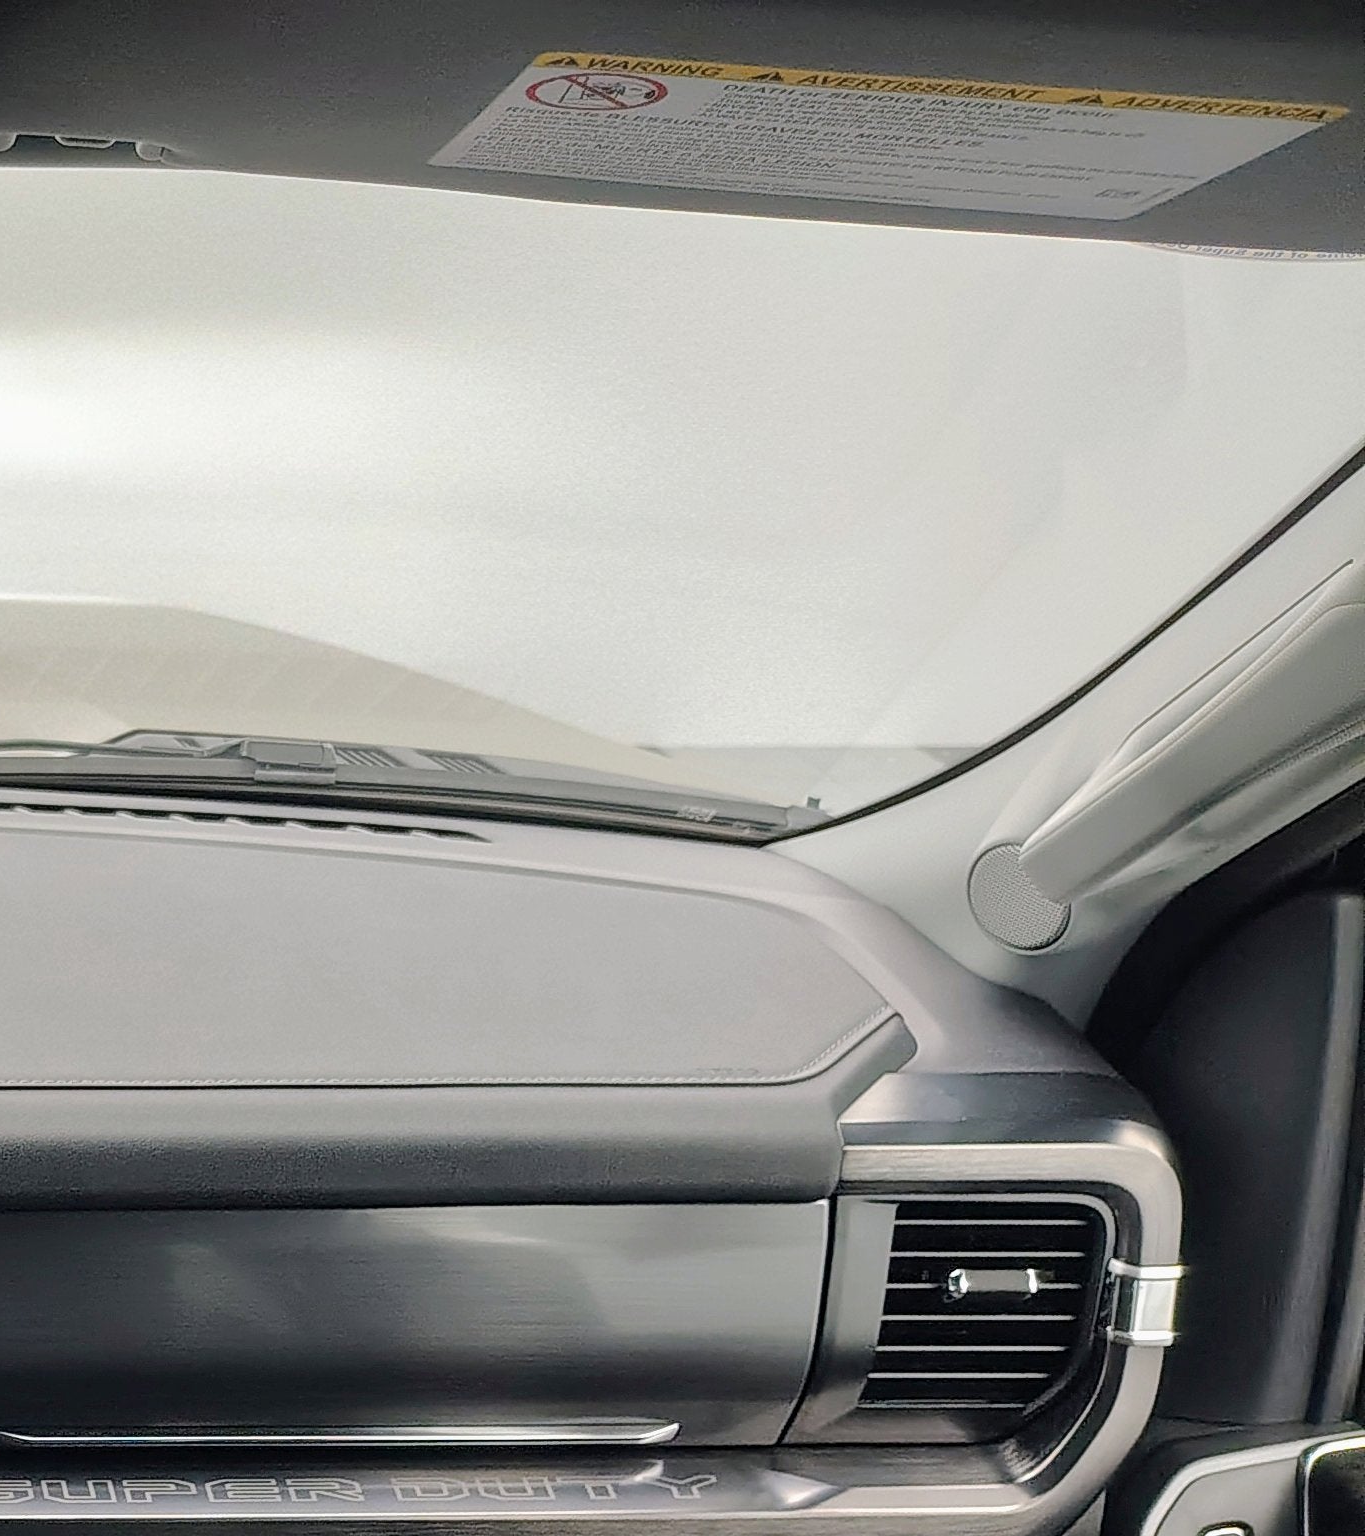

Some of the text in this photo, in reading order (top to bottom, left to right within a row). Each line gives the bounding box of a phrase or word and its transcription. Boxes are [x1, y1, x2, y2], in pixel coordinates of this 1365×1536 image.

[587, 57, 724, 77] WARNING
[796, 74, 1046, 100] AVERTISSEMENT
[1113, 95, 1328, 121] ADVERTENCIA
[391, 1473, 717, 1503] DUTY
